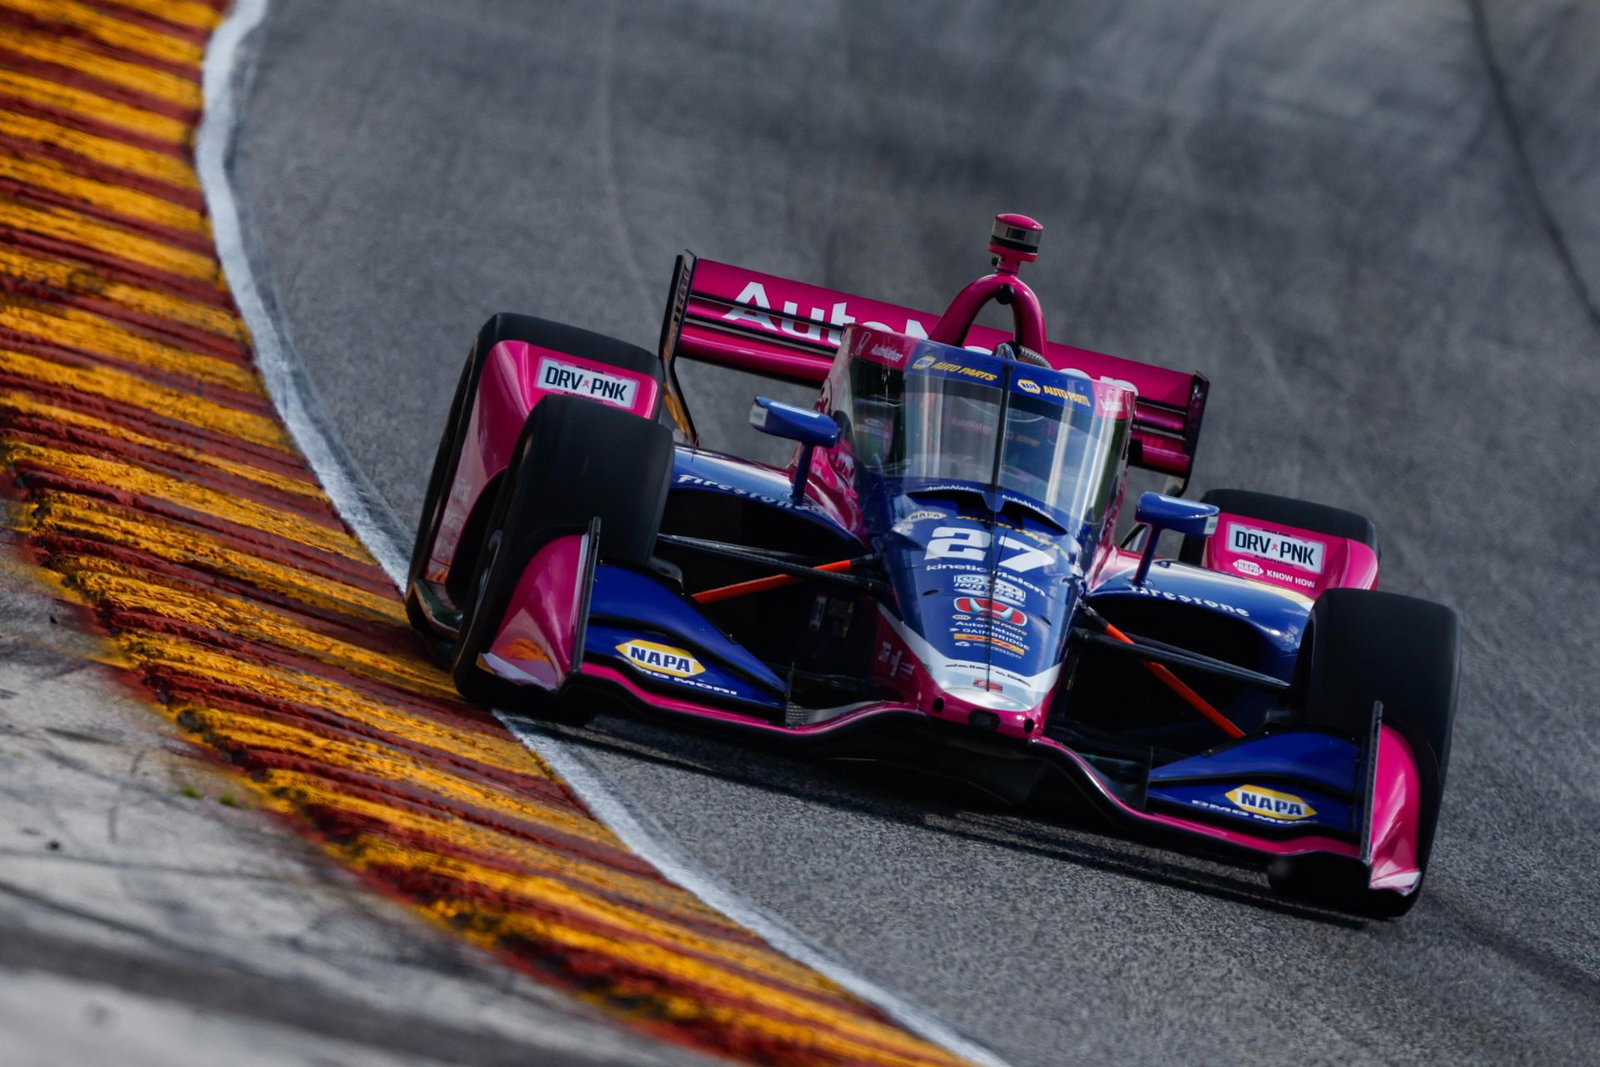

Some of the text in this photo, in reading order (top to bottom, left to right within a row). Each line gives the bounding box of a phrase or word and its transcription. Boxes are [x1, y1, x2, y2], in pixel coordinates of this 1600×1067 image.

[931, 362, 961, 372] AUTO
[958, 367, 998, 381] PARTS
[545, 366, 627, 401] DRV PNK
[1043, 385, 1069, 400] AUTO
[924, 526, 1055, 573] 27
[1235, 531, 1271, 554] DRV
[1280, 541, 1315, 566] PNK
[926, 563, 988, 573] kinetic
[1266, 570, 1294, 583] KNOW
[1294, 577, 1316, 589] HOW
[631, 646, 690, 673] NAPA
[1242, 792, 1302, 815] NAPA
